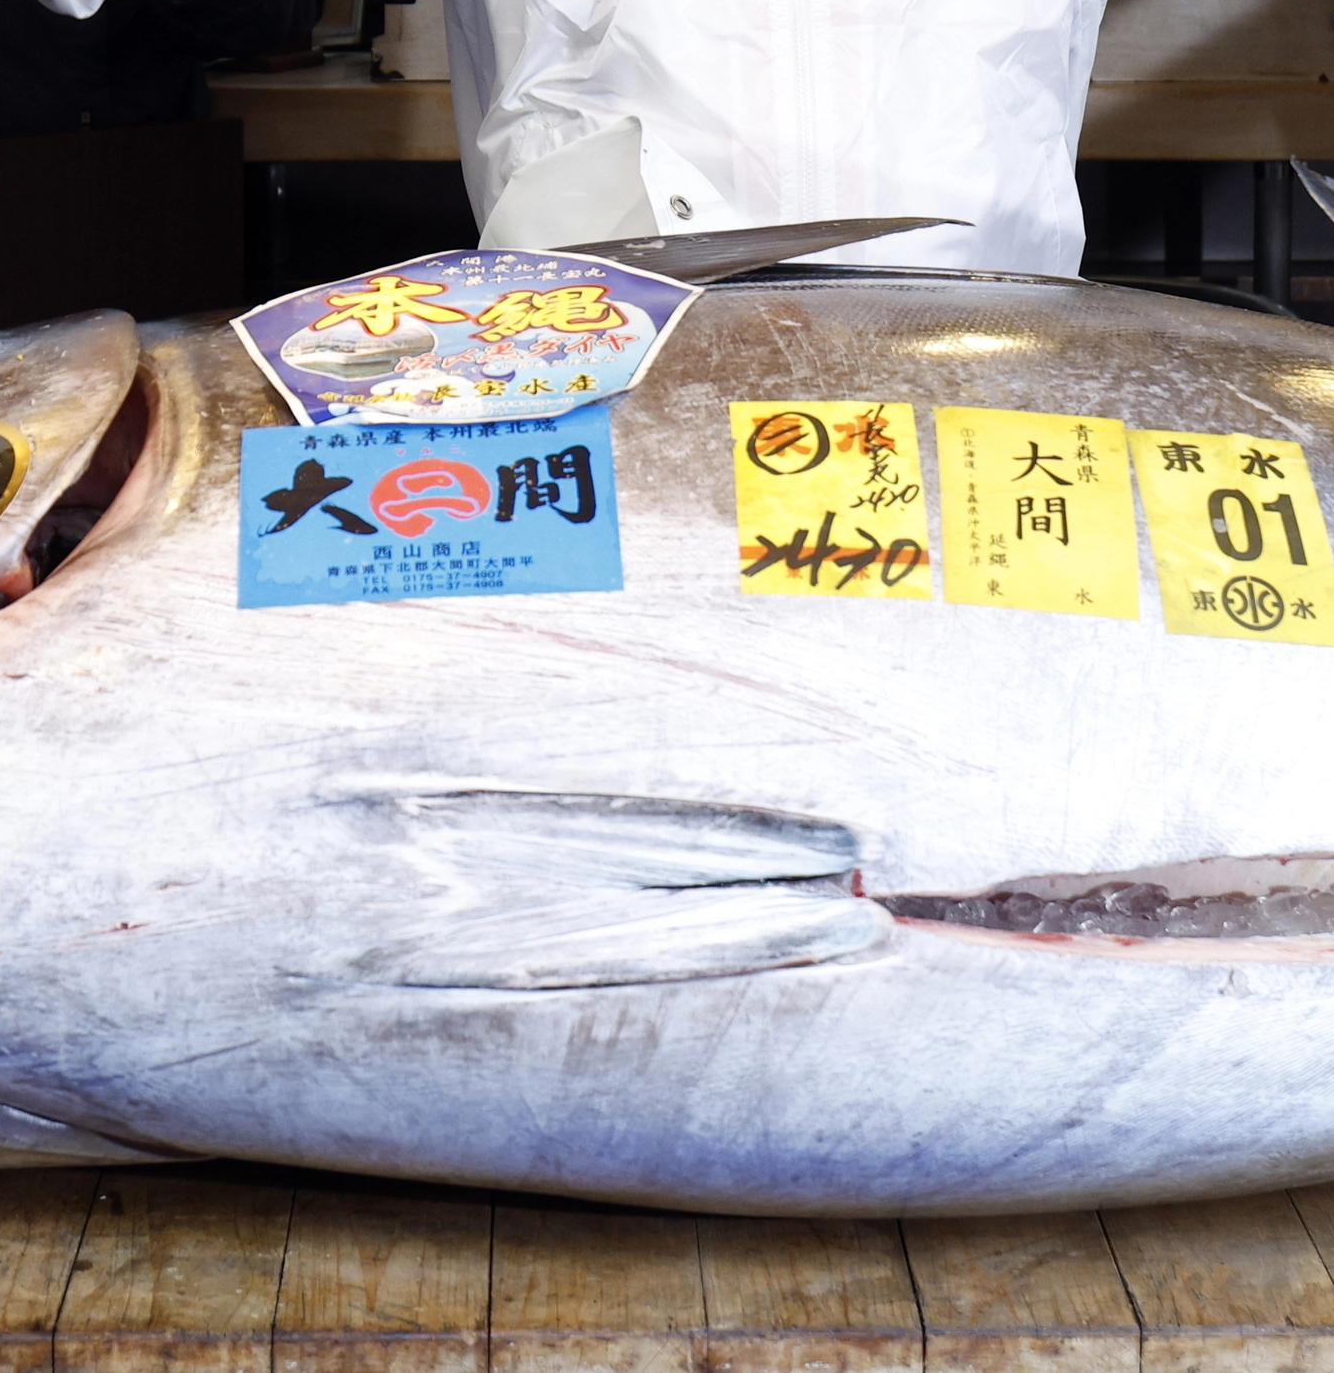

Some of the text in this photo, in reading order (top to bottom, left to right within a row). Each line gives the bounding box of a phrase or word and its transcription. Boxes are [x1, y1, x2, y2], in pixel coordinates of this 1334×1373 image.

[309, 275, 629, 343] 本縄
[299, 418, 558, 451] 青森県産 本州最北端
[1070, 423, 1099, 484] 青森県
[1011, 440, 1074, 547] 大間
[373, 541, 482, 560] 西山商店
[1208, 488, 1309, 567] 01
[363, 576, 388, 585] TEL
[363, 585, 389, 595] FAX
